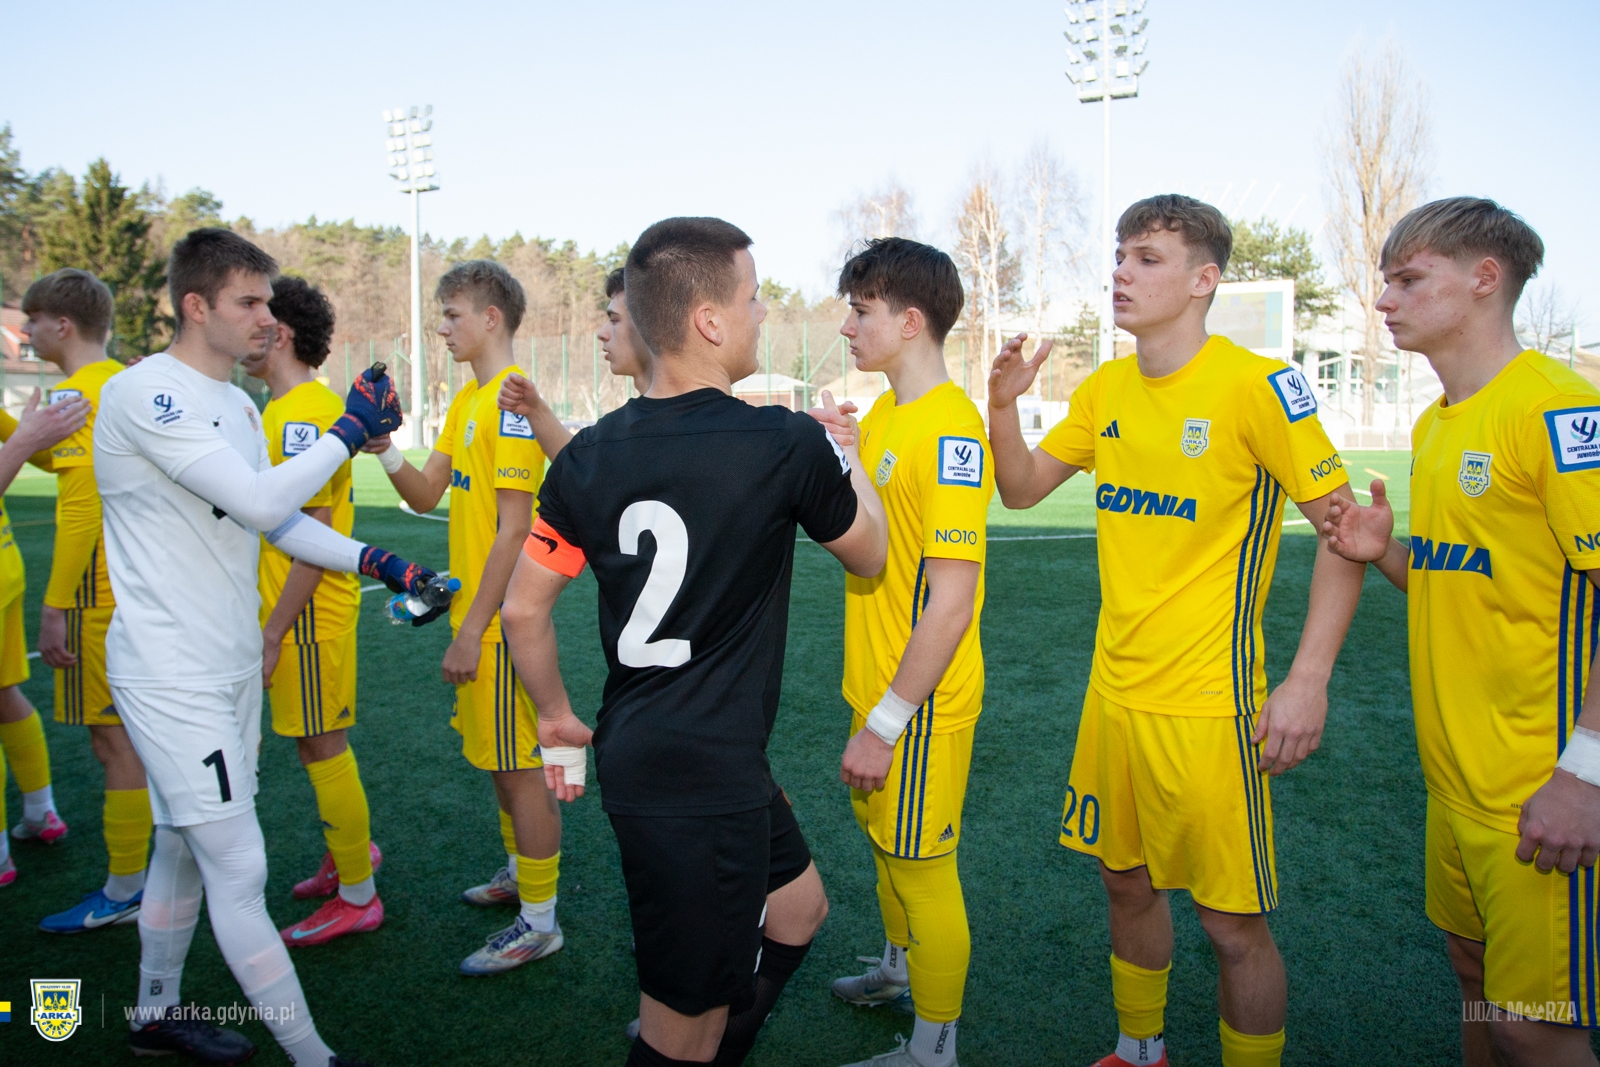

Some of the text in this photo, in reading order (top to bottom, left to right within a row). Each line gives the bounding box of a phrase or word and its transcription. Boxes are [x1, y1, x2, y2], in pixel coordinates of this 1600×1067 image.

[1567, 444, 1598, 453] CENTRALNA
[497, 466, 530, 480] NO10
[1310, 453, 1343, 482] NO10
[1463, 474, 1484, 482] ARKA
[1096, 483, 1196, 523] GDYNIA
[935, 529, 977, 545] NO10
[1410, 535, 1493, 580] YNIA
[617, 500, 691, 668] 2
[202, 749, 232, 803] 1
[1062, 785, 1099, 845] 20
